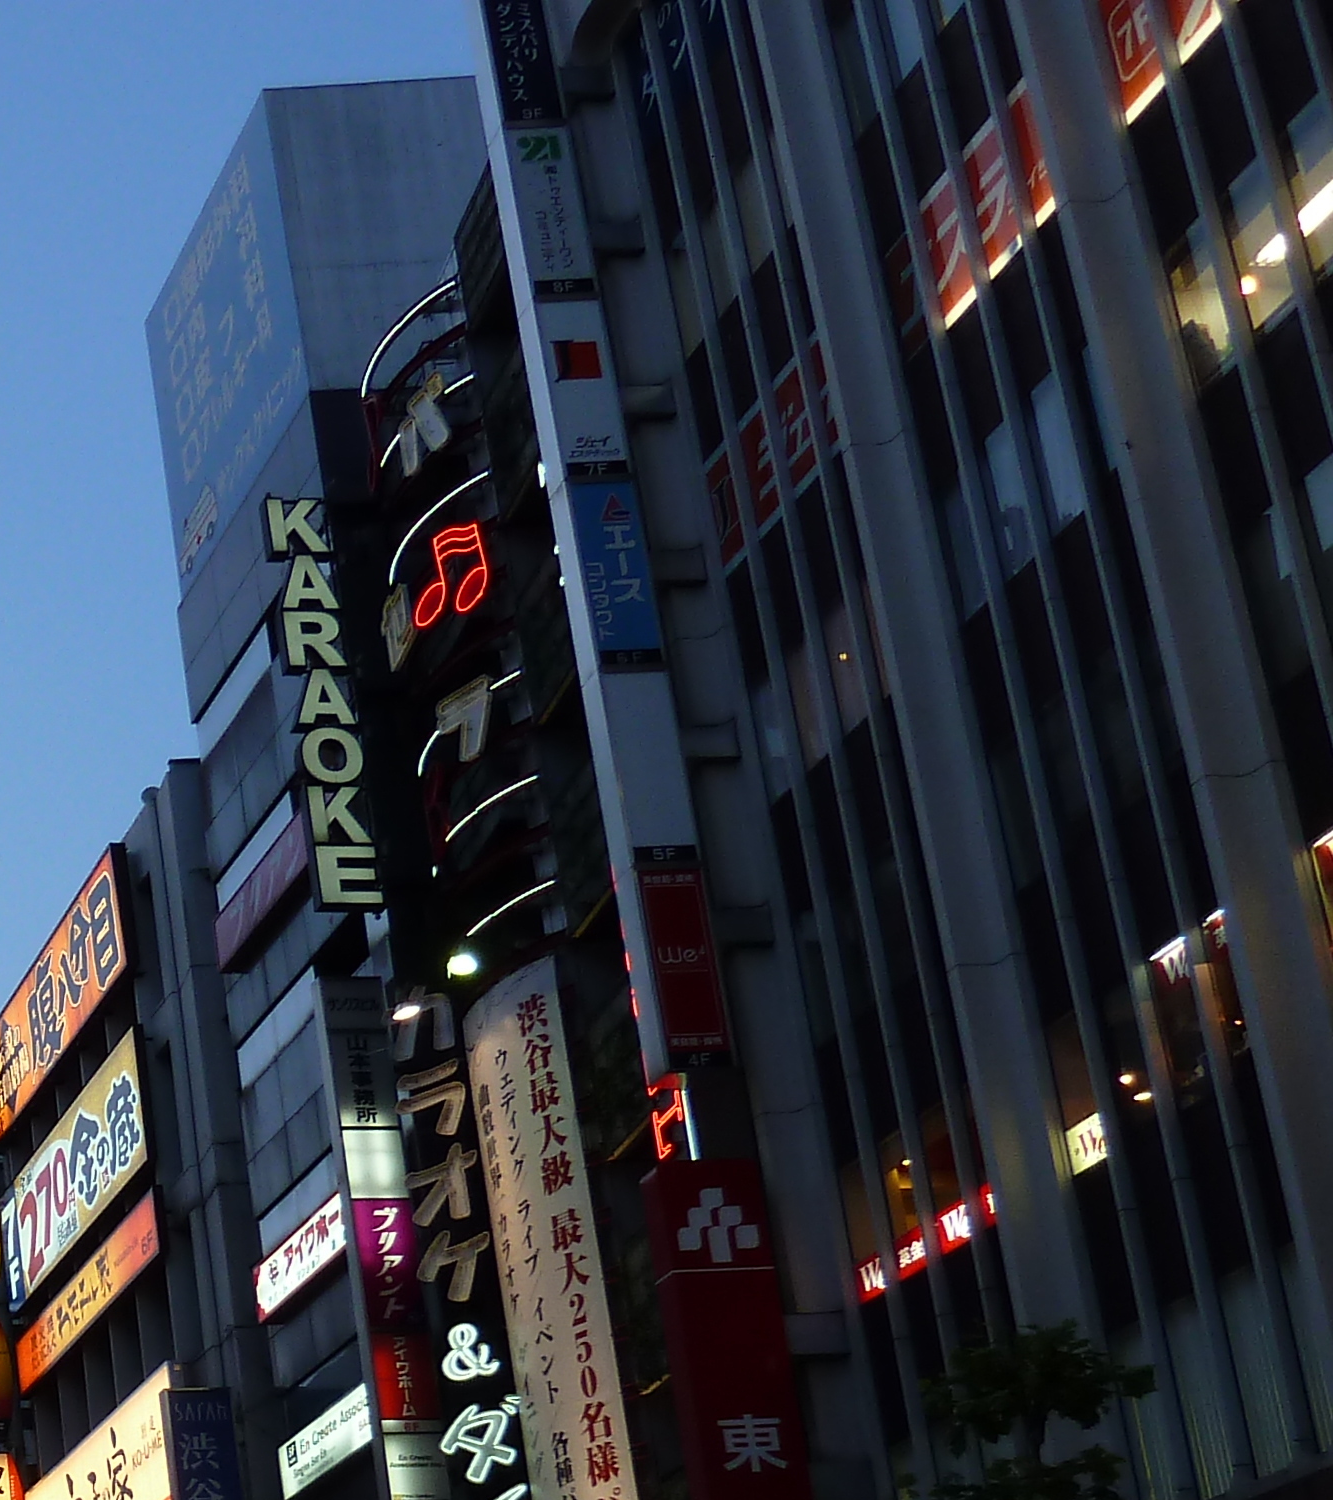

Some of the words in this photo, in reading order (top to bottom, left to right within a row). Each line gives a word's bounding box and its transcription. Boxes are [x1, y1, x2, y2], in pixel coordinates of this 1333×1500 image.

[521, 106, 545, 120] 9F
[551, 280, 575, 293] 8F
[584, 462, 608, 475] 7F
[601, 523, 643, 604] エース
[267, 497, 383, 904] KARAOKE
[652, 848, 676, 861] 5F
[346, 1034, 379, 1124] 山本事務所
[516, 992, 576, 1198] 渋谷最大級
[688, 1052, 711, 1067] 4F
[69, 1072, 141, 1213] 金の蔵
[1, 1197, 20, 1300] 7F
[392, 1335, 417, 1418] アイワホーム
[442, 1323, 500, 1382] &
